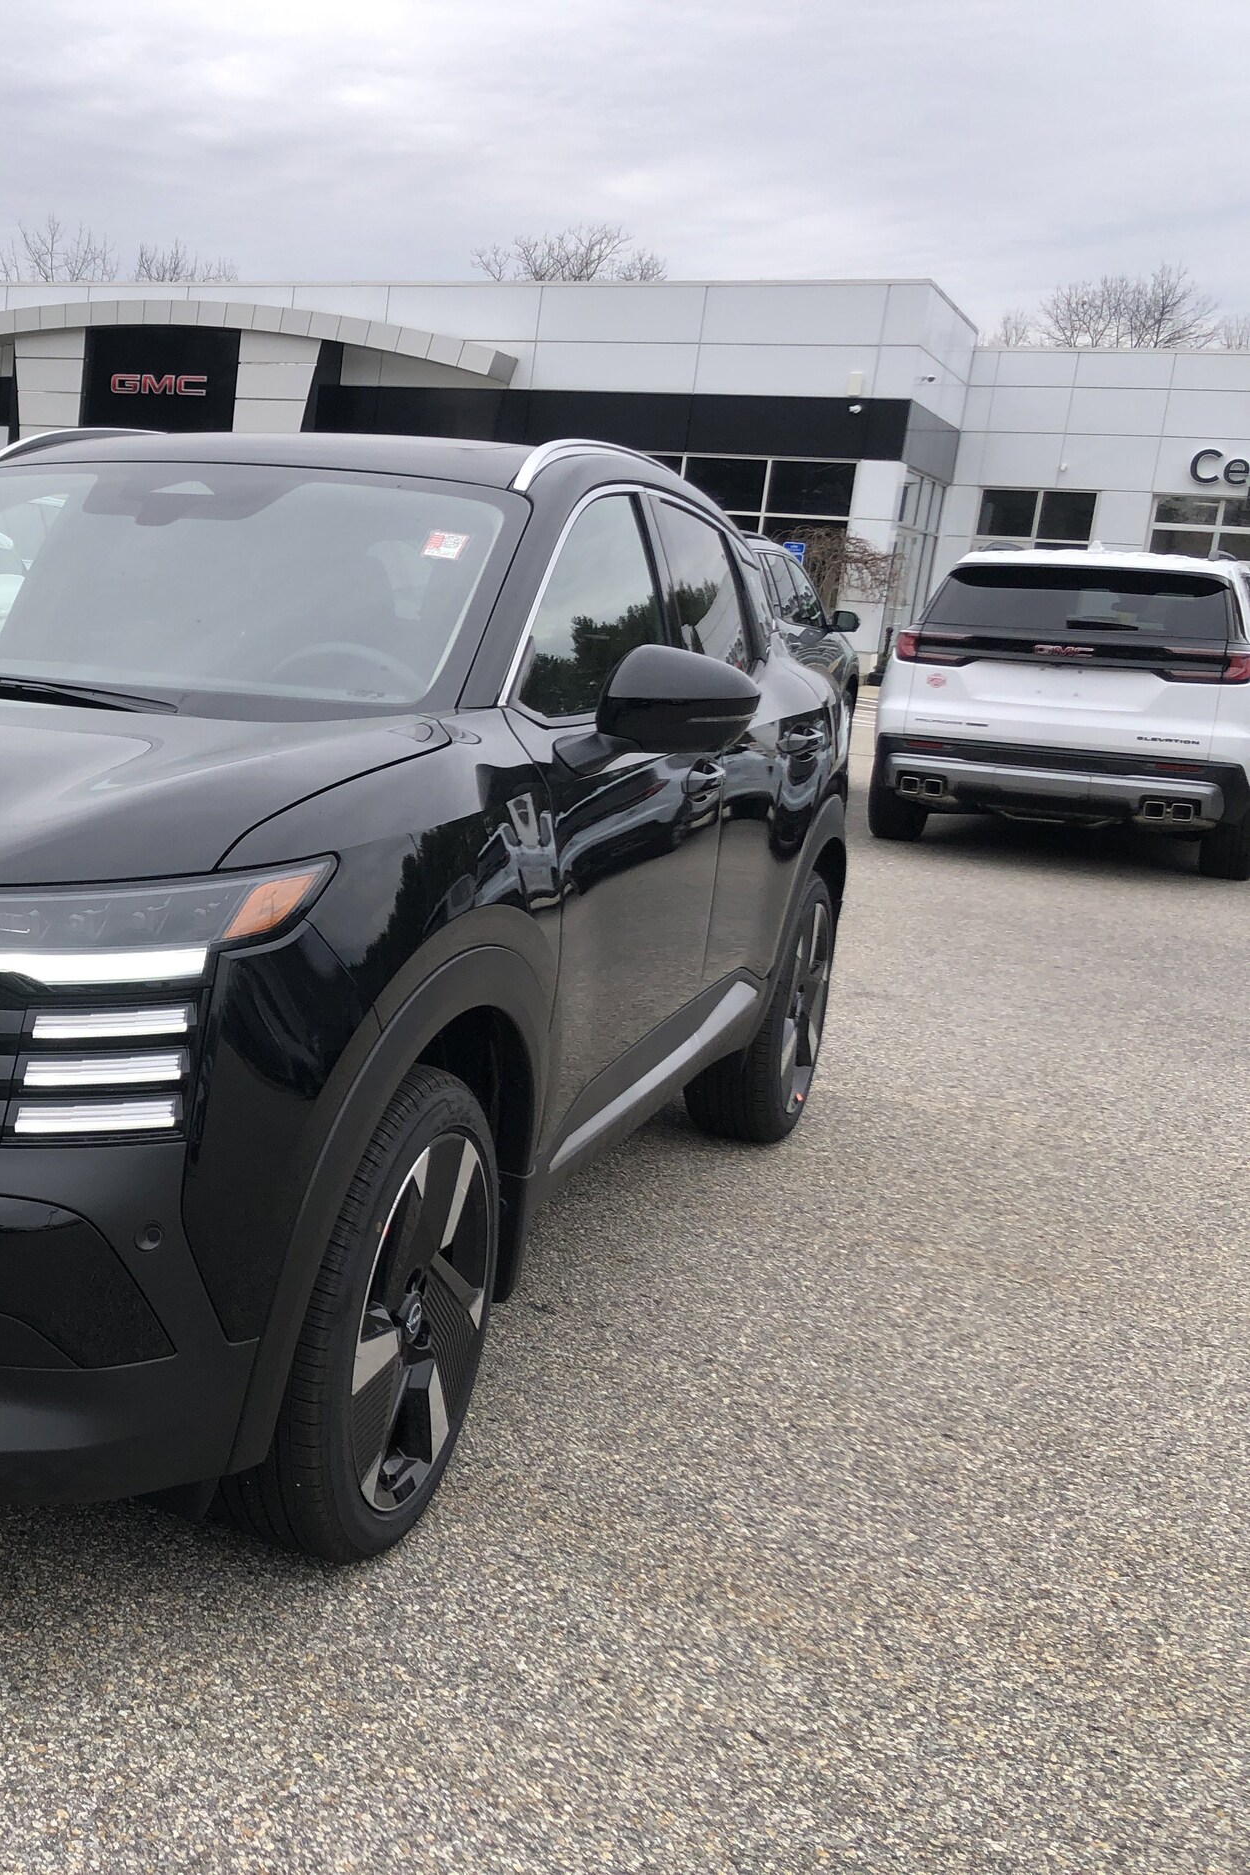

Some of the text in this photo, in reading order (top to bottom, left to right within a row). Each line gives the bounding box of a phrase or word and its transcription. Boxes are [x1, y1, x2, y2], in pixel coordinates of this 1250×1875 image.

[111, 373, 208, 396] GMC
[1190, 448, 1250, 485] Ce
[1034, 644, 1095, 659] GMC
